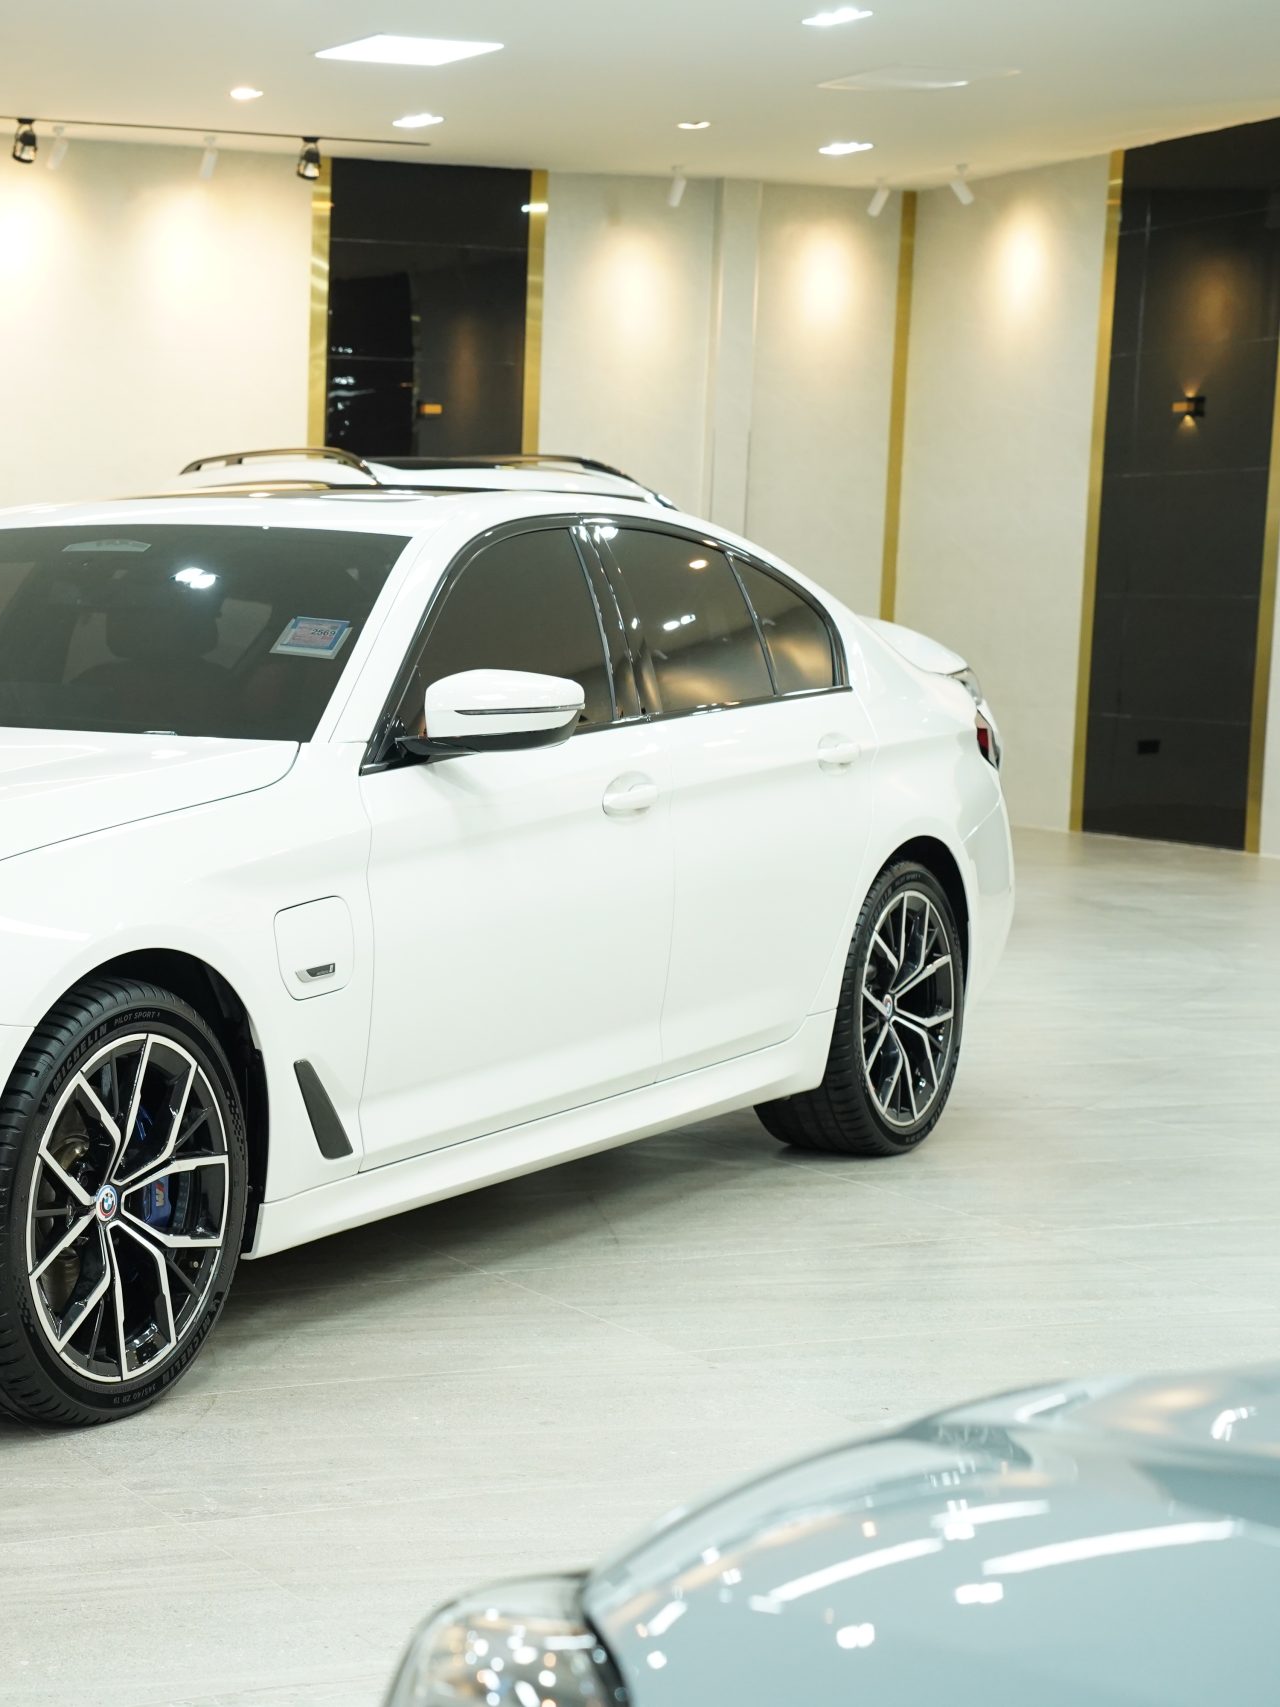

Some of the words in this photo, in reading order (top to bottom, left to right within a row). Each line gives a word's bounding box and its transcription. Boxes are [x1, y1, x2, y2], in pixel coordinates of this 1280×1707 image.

[311, 628, 336, 637] 2569
[53, 1024, 107, 1092] MICHELIN
[134, 1011, 155, 1019] SPORT
